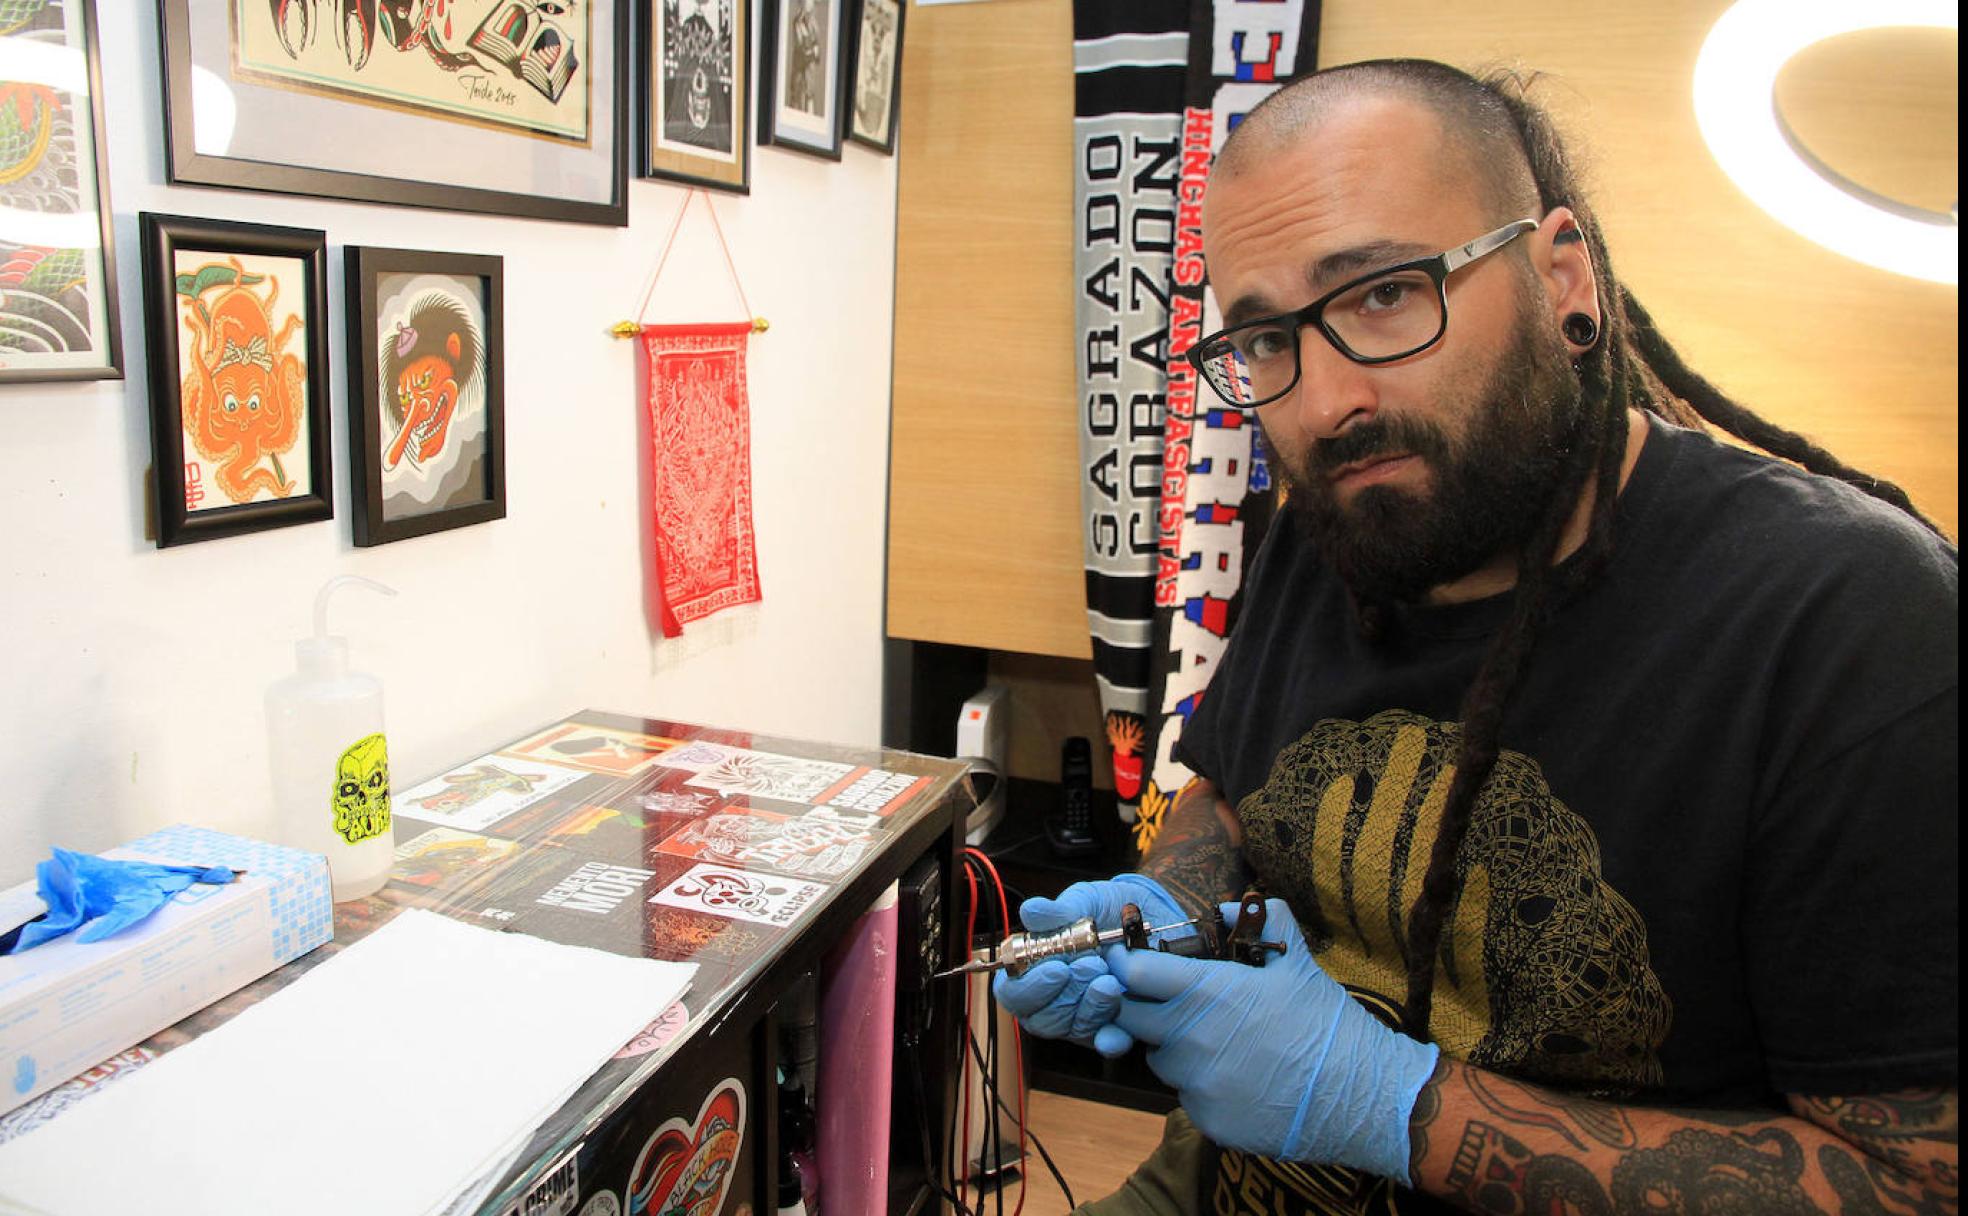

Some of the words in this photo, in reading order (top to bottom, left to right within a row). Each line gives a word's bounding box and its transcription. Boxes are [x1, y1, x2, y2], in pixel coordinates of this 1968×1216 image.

[1173, 107, 1213, 286] HINCHAS
[1086, 134, 1122, 557] SAGRADO
[1129, 135, 1179, 555] CORAZON
[1155, 296, 1202, 607] ANTIFASCISTAS
[535, 861, 610, 906] MEMENTO
[560, 865, 657, 914] MORI
[771, 885, 820, 922] ECLIPSE
